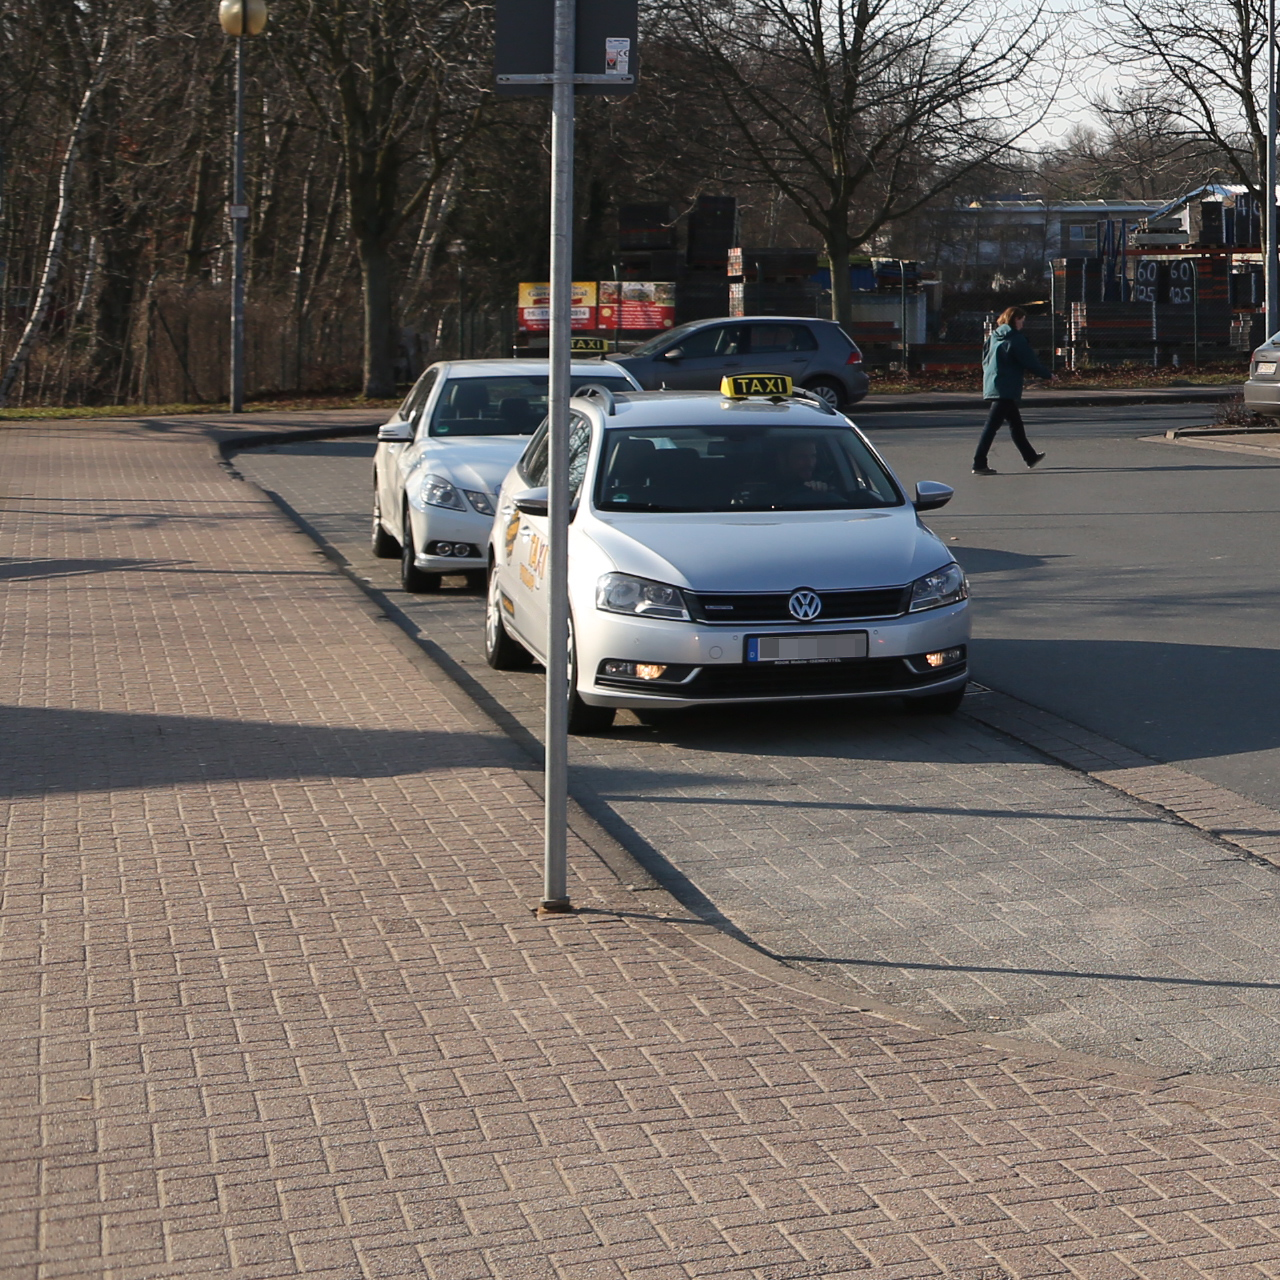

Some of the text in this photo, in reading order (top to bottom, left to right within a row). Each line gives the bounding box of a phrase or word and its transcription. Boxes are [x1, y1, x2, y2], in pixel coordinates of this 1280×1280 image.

[1137, 261, 1157, 281] 60
[1170, 261, 1189, 280] 60
[571, 340, 600, 349] TAXI
[737, 379, 783, 393] TAXI
